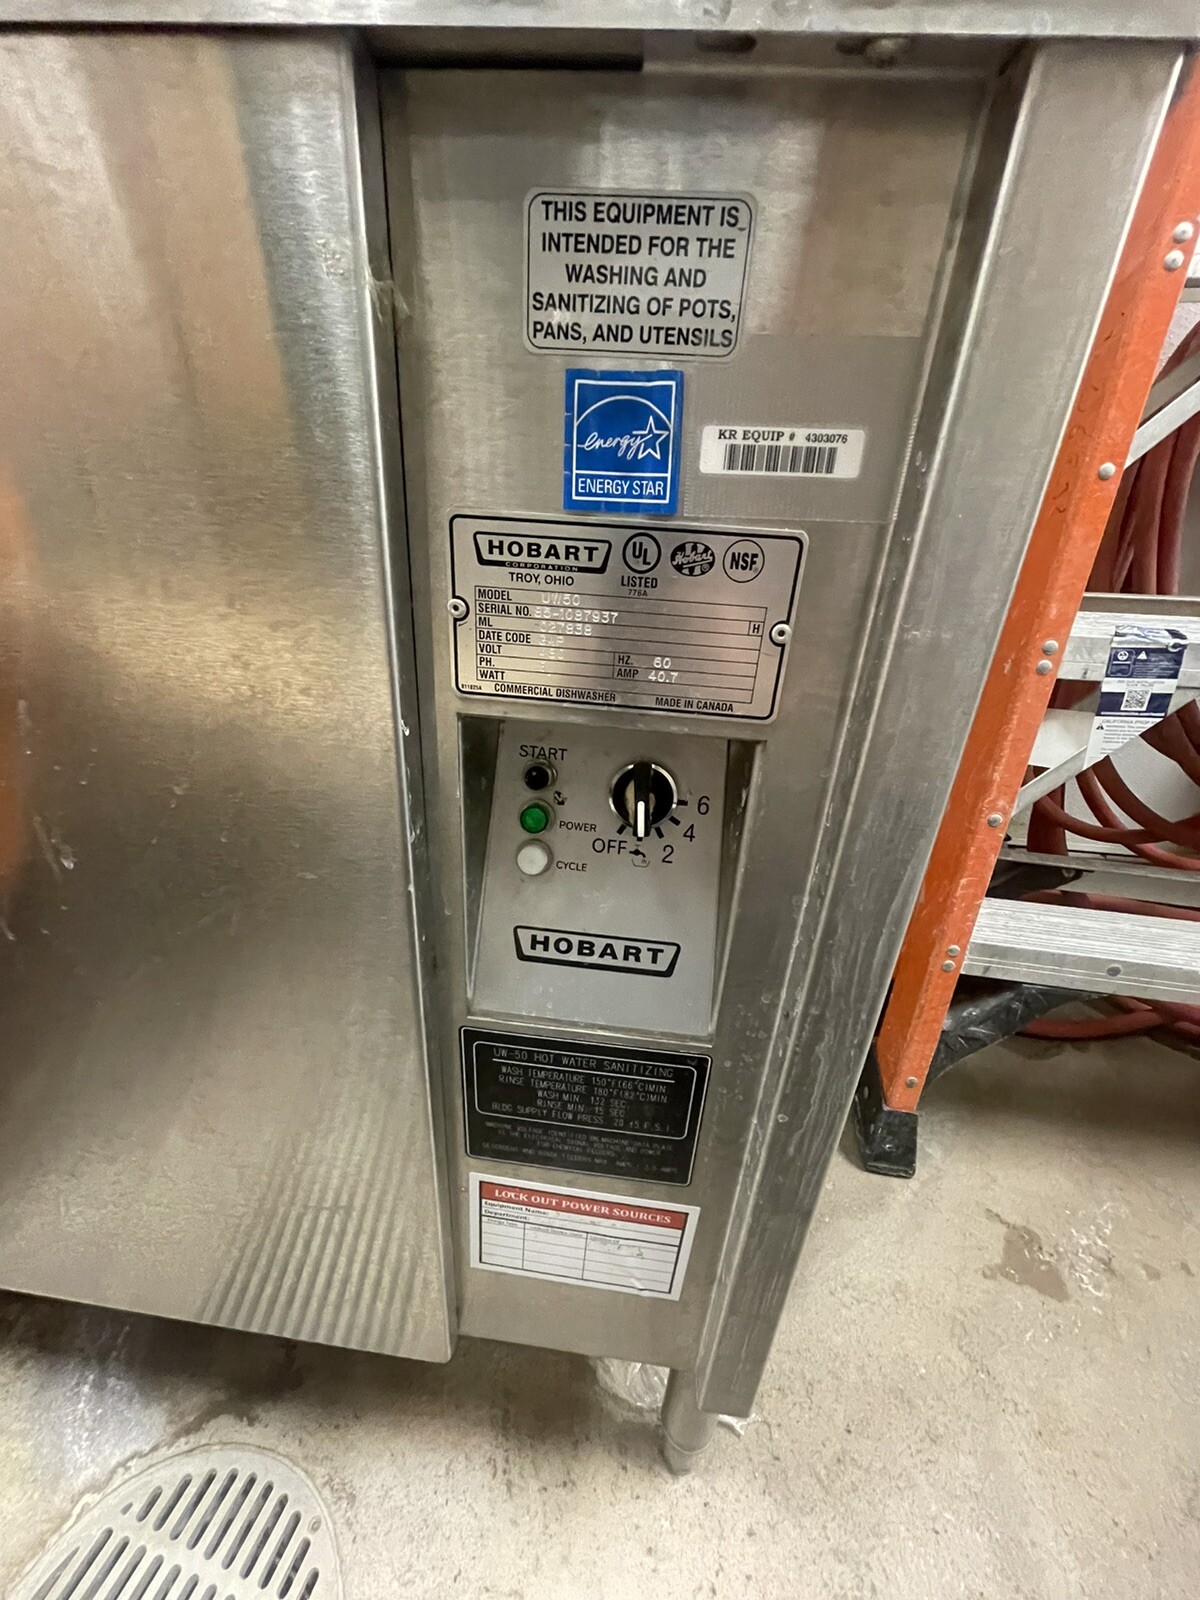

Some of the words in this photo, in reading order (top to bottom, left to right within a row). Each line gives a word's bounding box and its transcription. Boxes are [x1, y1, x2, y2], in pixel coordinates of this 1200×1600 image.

[541, 200, 587, 222] THIS
[593, 202, 715, 226] EQUIPMENT
[720, 206, 739, 228] IS
[541, 232, 642, 255] INTENDED
[648, 236, 690, 256] FOR
[697, 238, 736, 258] THE
[565, 264, 658, 286] WASHING
[664, 268, 707, 288] AND
[532, 292, 640, 315] SANITIZING
[647, 297, 673, 316] OF
[679, 299, 736, 322] POTS,
[532, 321, 587, 345] PANS,
[592, 324, 633, 343] AND
[640, 326, 733, 348] UTENSILS
[718, 429, 738, 440] KR
[742, 430, 785, 443] EQUIP
[805, 432, 848, 444] 4303076
[577, 432, 642, 460] energy
[578, 478, 629, 495] ENERGY
[632, 480, 664, 496] STAR
[488, 539, 599, 563] HOBART
[632, 541, 651, 566] UL
[505, 561, 579, 572] CORPORATION
[730, 552, 759, 571] NSF
[509, 571, 541, 585] TROY,
[544, 574, 575, 587] OHIO
[621, 575, 658, 588] LISTED
[478, 589, 512, 601] MODEL
[478, 603, 512, 615] SERIAL
[516, 605, 532, 616] NO.
[752, 624, 760, 634] H
[478, 617, 493, 627] ML
[478, 630, 503, 642] DATE
[505, 632, 531, 644] CODE
[478, 644, 503, 655] VOLT
[479, 657, 495, 667] PH.
[618, 655, 634, 666] HZ.
[653, 657, 672, 669] 60
[479, 669, 505, 681] WATT
[616, 668, 639, 679] AMP
[648, 670, 679, 683] 40.7
[494, 683, 553, 697] COMMERCIAL
[555, 688, 616, 702] DISHWASHER
[655, 697, 681, 709] MADE
[684, 699, 694, 709] IN
[696, 700, 734, 712] CANADA
[519, 744, 568, 761] START
[697, 796, 710, 815] 6
[559, 821, 597, 833] POWER
[683, 824, 696, 842] 4
[592, 838, 628, 855] OFF
[662, 845, 675, 864] 2
[556, 860, 588, 872] CYCLE
[530, 934, 664, 965] HOBART
[493, 1047, 528, 1060] UW-50
[534, 1052, 554, 1064] HOT
[561, 1056, 597, 1069] WATER
[603, 1060, 674, 1078] SANITIZING
[501, 1065, 523, 1075] WASH
[528, 1068, 585, 1084] TEMPERATURE
[499, 1074, 525, 1086] RINSE
[531, 1078, 587, 1094] TEMPERATURE
[537, 1090, 559, 1100] WASH
[517, 1105, 547, 1117] SUPPLY
[552, 1110, 573, 1120] FLOW
[537, 1098, 562, 1110] RINSE
[484, 1201, 524, 1212] Equipment
[494, 1188, 528, 1202] LOCK
[531, 1195, 559, 1207] OUT
[562, 1200, 610, 1215] POWER
[612, 1207, 672, 1224] SOURCES
